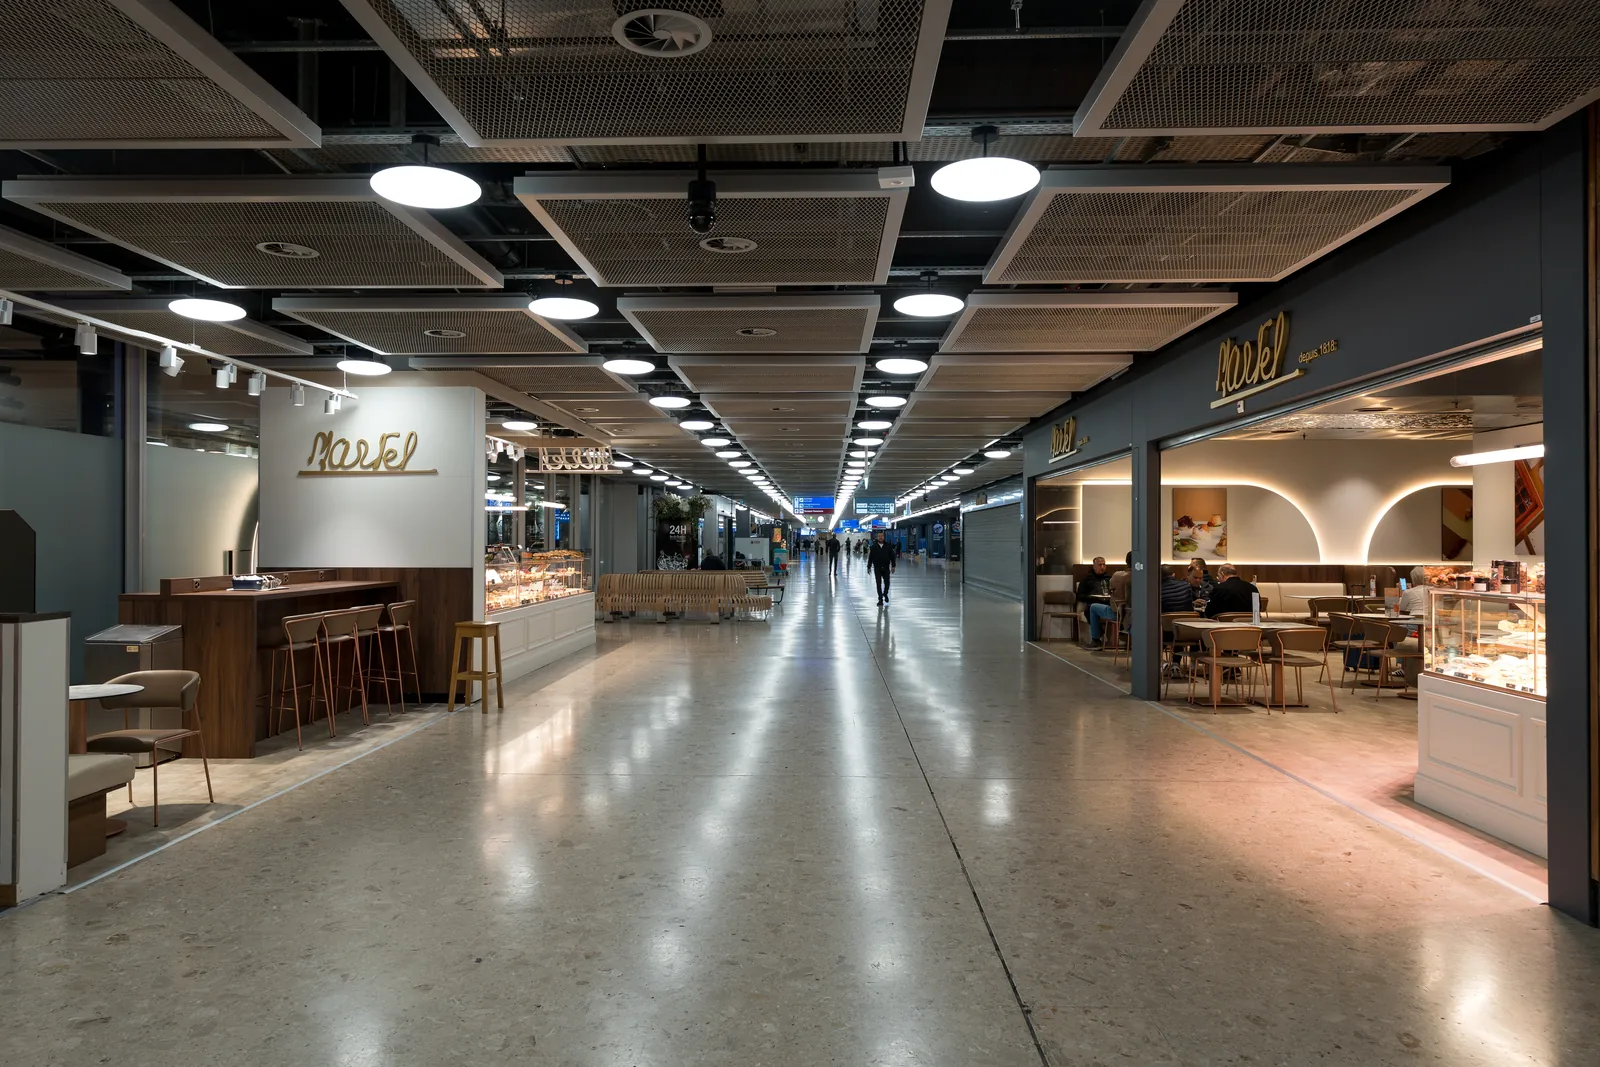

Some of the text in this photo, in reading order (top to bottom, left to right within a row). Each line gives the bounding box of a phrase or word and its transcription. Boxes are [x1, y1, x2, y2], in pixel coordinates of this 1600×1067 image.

[1215, 310, 1287, 397] Martel
[308, 430, 417, 471] Martel
[1050, 416, 1075, 457] Martel
[669, 525, 687, 535] 24H
